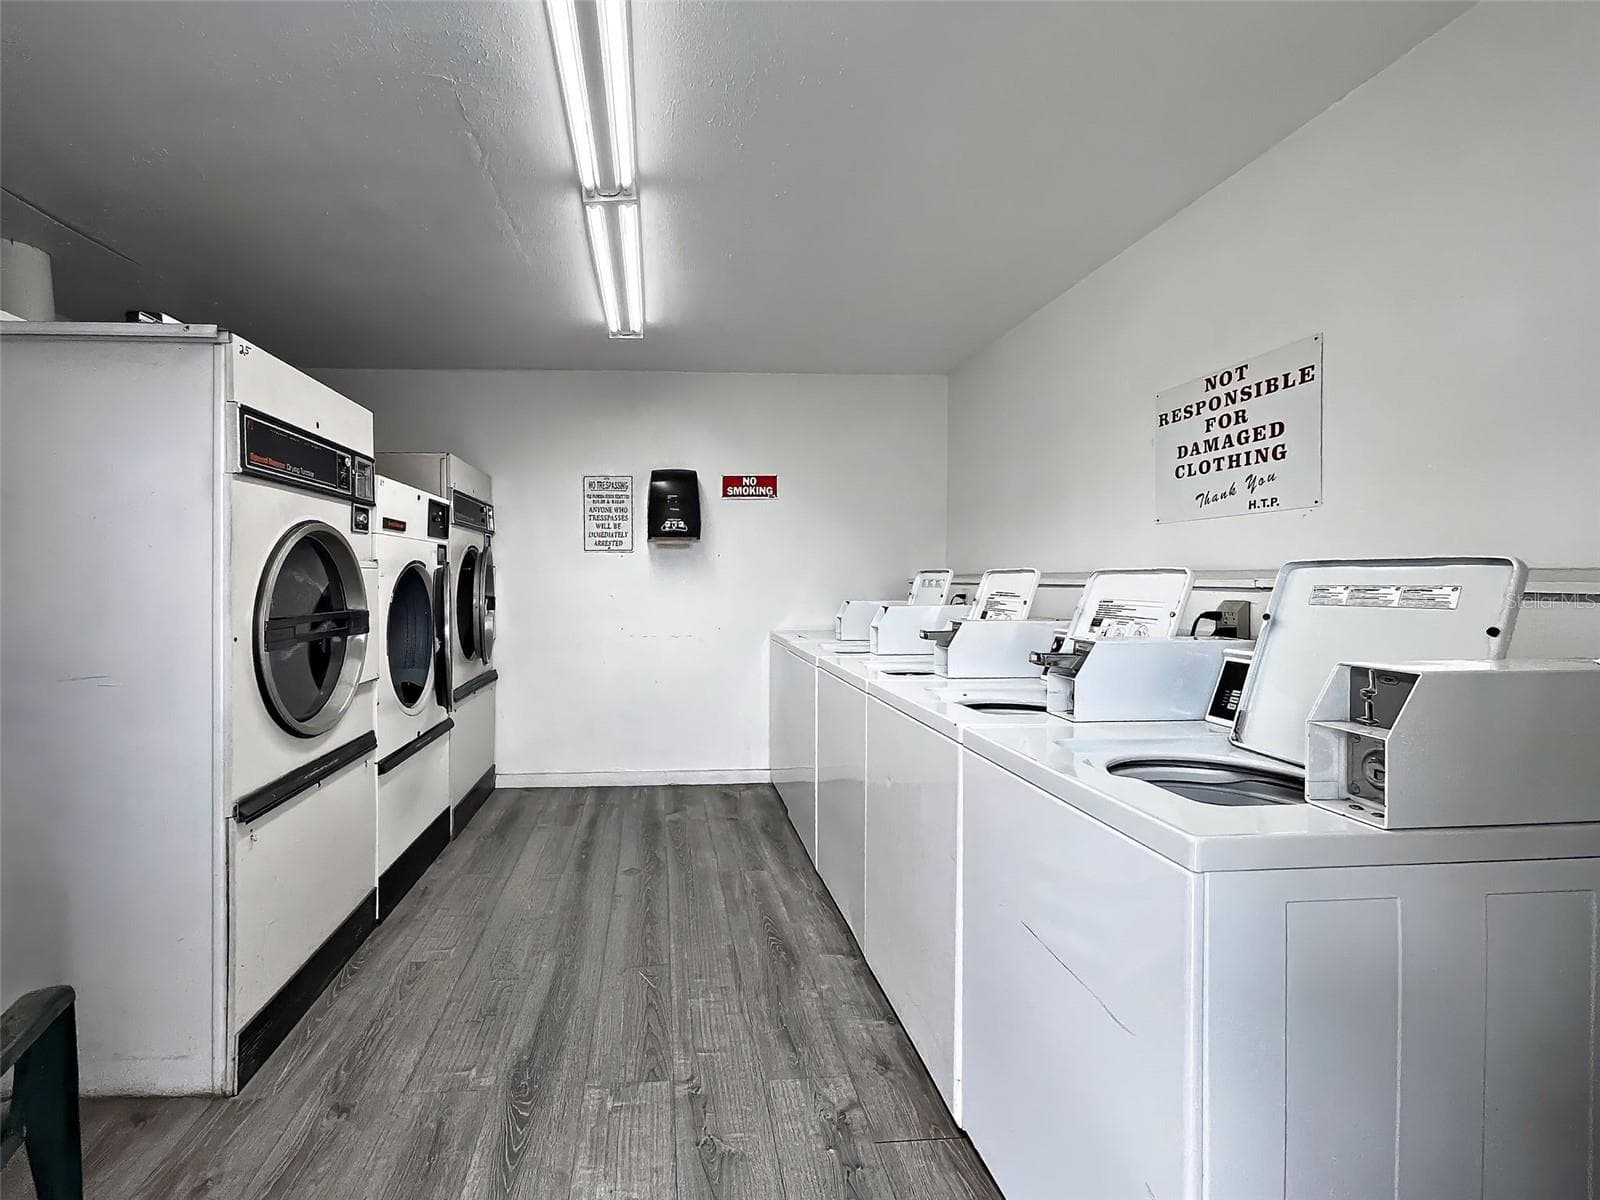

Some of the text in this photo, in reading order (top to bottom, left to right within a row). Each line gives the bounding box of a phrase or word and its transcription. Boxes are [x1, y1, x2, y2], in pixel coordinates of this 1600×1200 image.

[1204, 364, 1249, 393] NOT
[1158, 365, 1315, 428] RESPONSIBLE
[1204, 409, 1249, 434] FOR
[1176, 421, 1286, 460] DAMAGED
[1174, 443, 1288, 480] CLOTHING
[588, 481, 629, 490] NO TRESPASSING
[742, 477, 757, 486] NO
[727, 486, 774, 496] SMOKING
[1195, 471, 1277, 509] Thank You
[1248, 497, 1280, 510] H.T.P.
[588, 506, 628, 514] ANYONE WHO
[588, 514, 629, 522] TRESSPASSES
[595, 522, 622, 530] WILL BE
[588, 531, 629, 539] IMMEDIATELY
